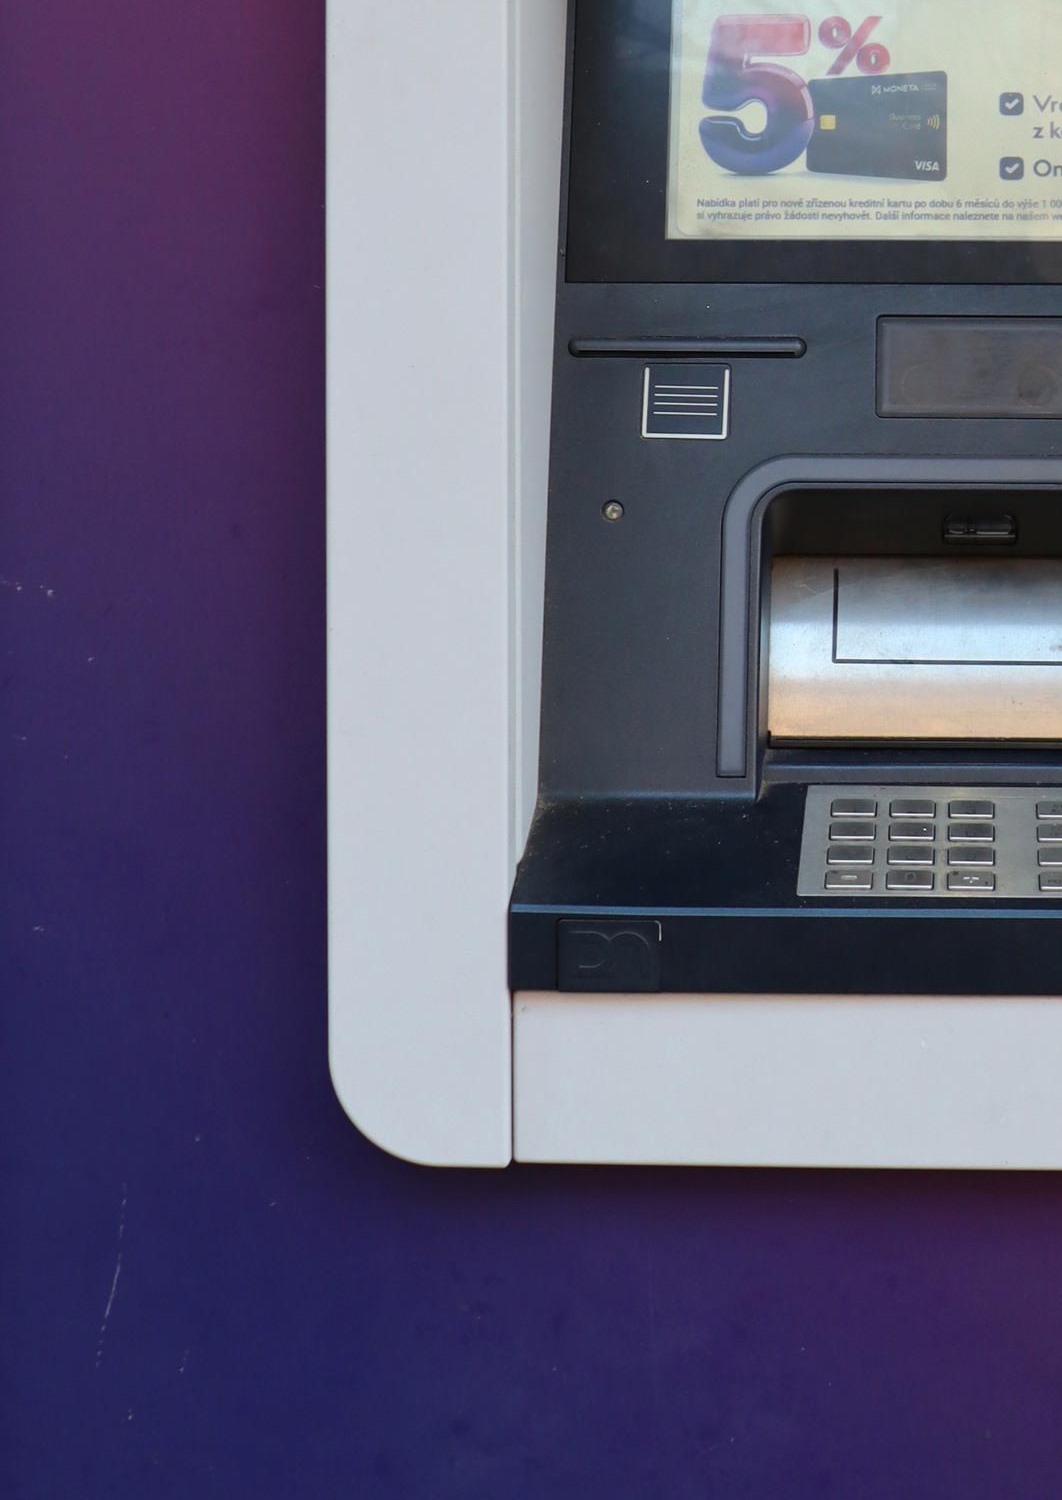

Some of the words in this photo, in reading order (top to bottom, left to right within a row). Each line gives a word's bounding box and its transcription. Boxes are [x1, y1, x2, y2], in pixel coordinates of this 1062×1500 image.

[1033, 128, 1043, 139] z
[914, 161, 940, 171] VISA
[762, 200, 779, 210] pro
[887, 198, 912, 208] kartu
[914, 201, 928, 211] po
[929, 199, 954, 208] dobu
[1002, 199, 1015, 209] do
[707, 210, 752, 222] vyhrazuje
[755, 210, 782, 222] právo
[902, 211, 951, 220] informace
[1002, 213, 1014, 221] na
